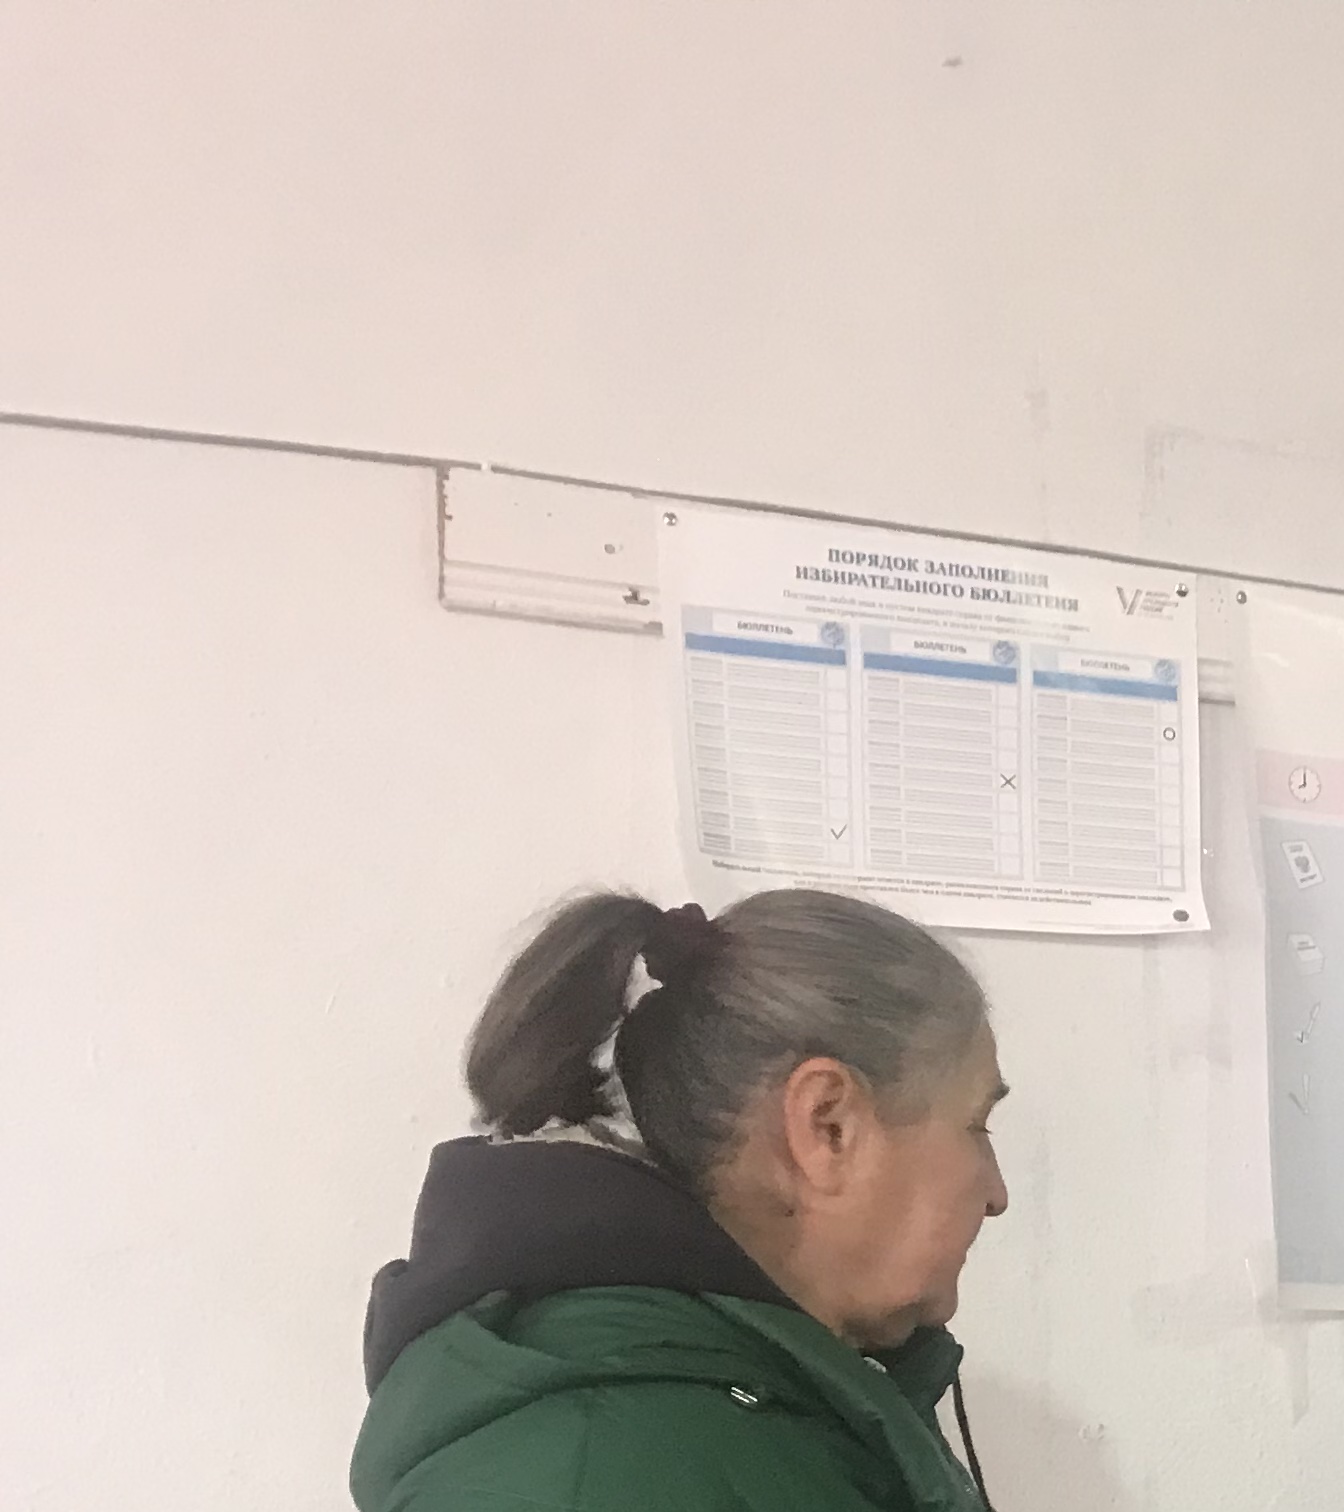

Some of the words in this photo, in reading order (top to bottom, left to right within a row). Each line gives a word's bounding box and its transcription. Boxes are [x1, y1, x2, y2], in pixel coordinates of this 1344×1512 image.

[795, 565, 965, 598] ИЗБИРАТЕЛЬНОГО
[970, 586, 1079, 613] БЮЛЛЕТЕНЯ
[828, 548, 919, 573] ПОРЯДОК
[924, 559, 1049, 589] ЗАПОЛНЕНИЯ
